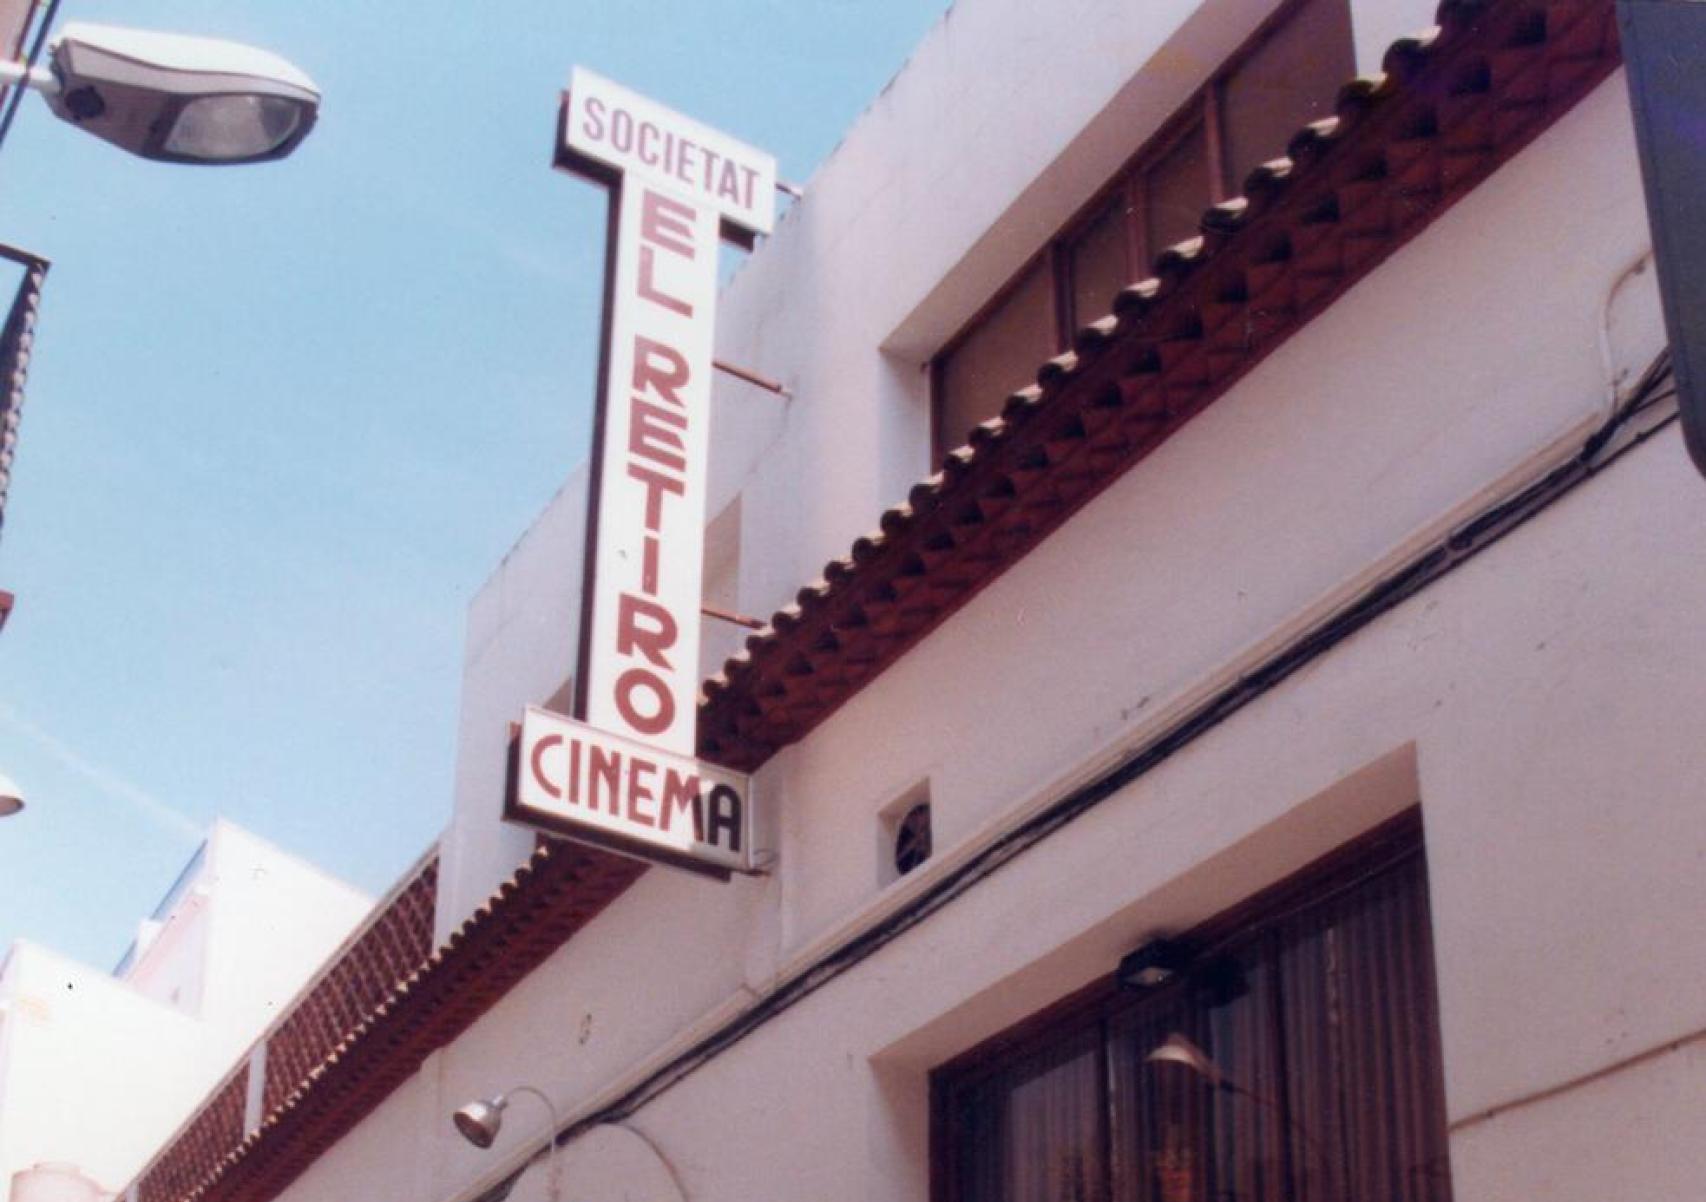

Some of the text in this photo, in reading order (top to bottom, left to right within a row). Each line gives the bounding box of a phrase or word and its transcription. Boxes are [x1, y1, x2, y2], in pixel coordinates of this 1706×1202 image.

[583, 97, 760, 211] SOCIETAT
[613, 188, 697, 736] EL RETIRO
[530, 734, 741, 852] CINEMA
